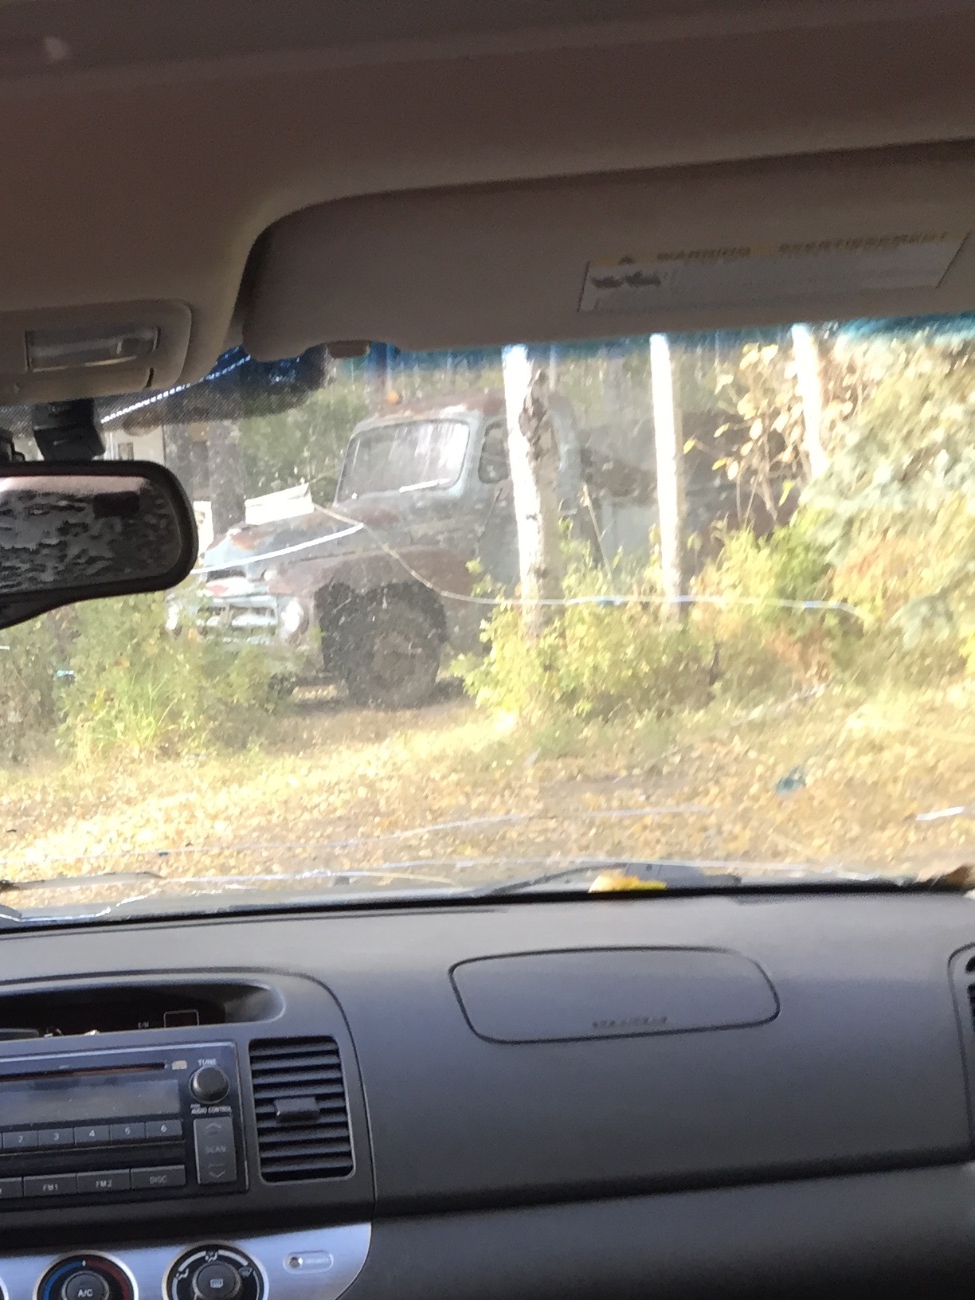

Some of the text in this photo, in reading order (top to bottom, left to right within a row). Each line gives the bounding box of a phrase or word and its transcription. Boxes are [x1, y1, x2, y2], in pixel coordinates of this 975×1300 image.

[124, 1126, 131, 1136] 5
[160, 1123, 168, 1133] 6
[53, 1132, 60, 1141] 3
[88, 1129, 96, 1138] 4
[17, 1135, 24, 1144] 2
[95, 1180, 113, 1188] FM2
[77, 1288, 94, 1298] A/C
